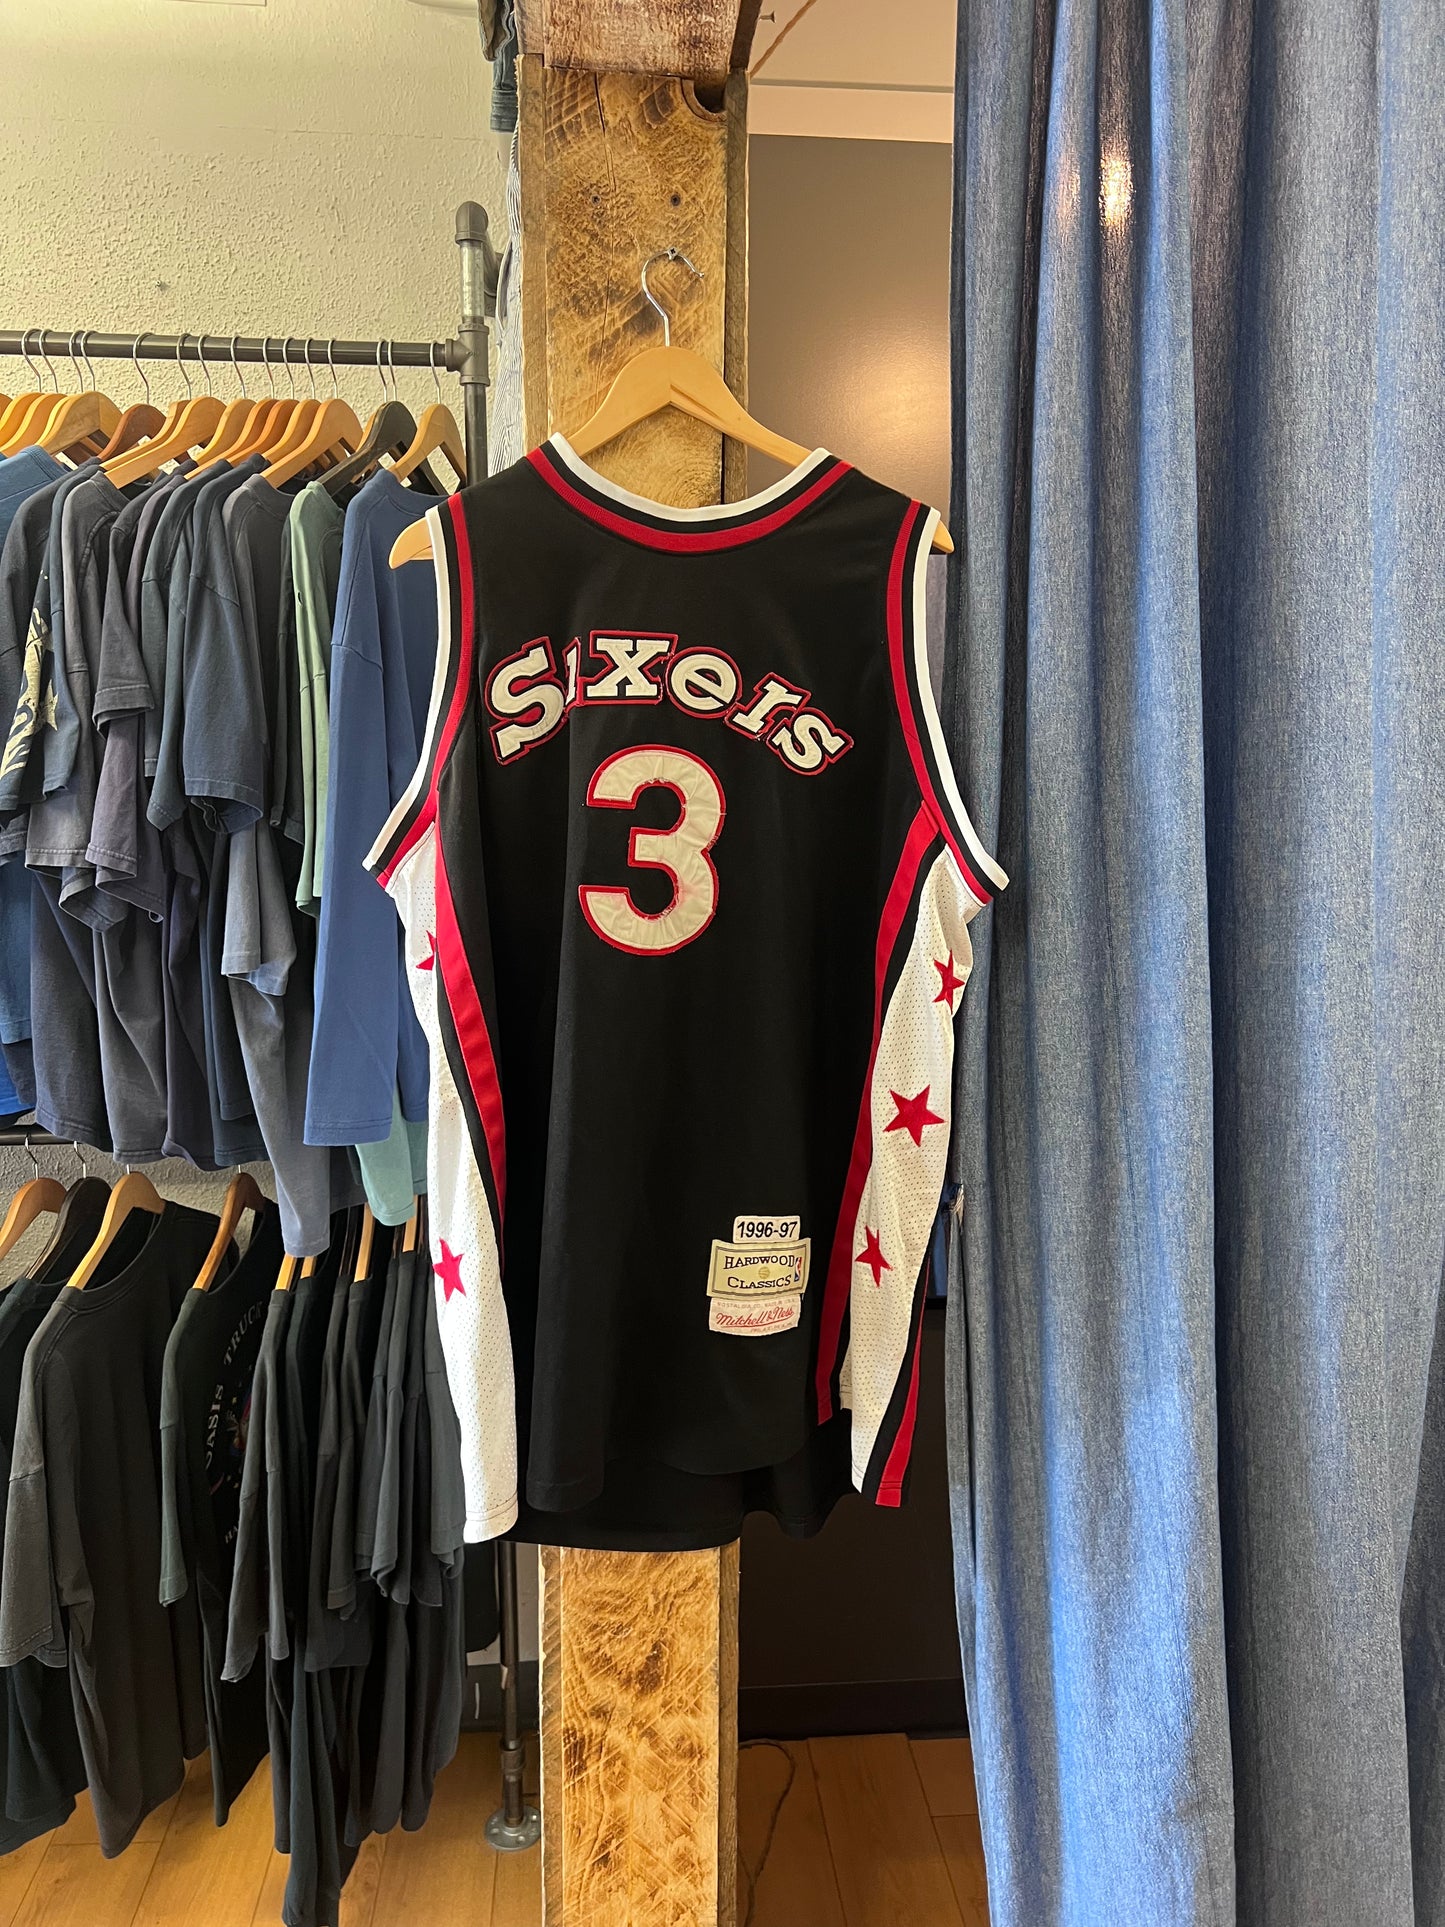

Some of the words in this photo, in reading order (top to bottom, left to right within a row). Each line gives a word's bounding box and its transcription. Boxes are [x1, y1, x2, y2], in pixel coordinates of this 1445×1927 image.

[578, 744, 726, 956] 3
[737, 1221, 798, 1238] 1996-97
[723, 1255, 795, 1270] HARDWOOD
[727, 1274, 792, 1289] CLASSICS
[716, 1310, 767, 1326] Mitchell
